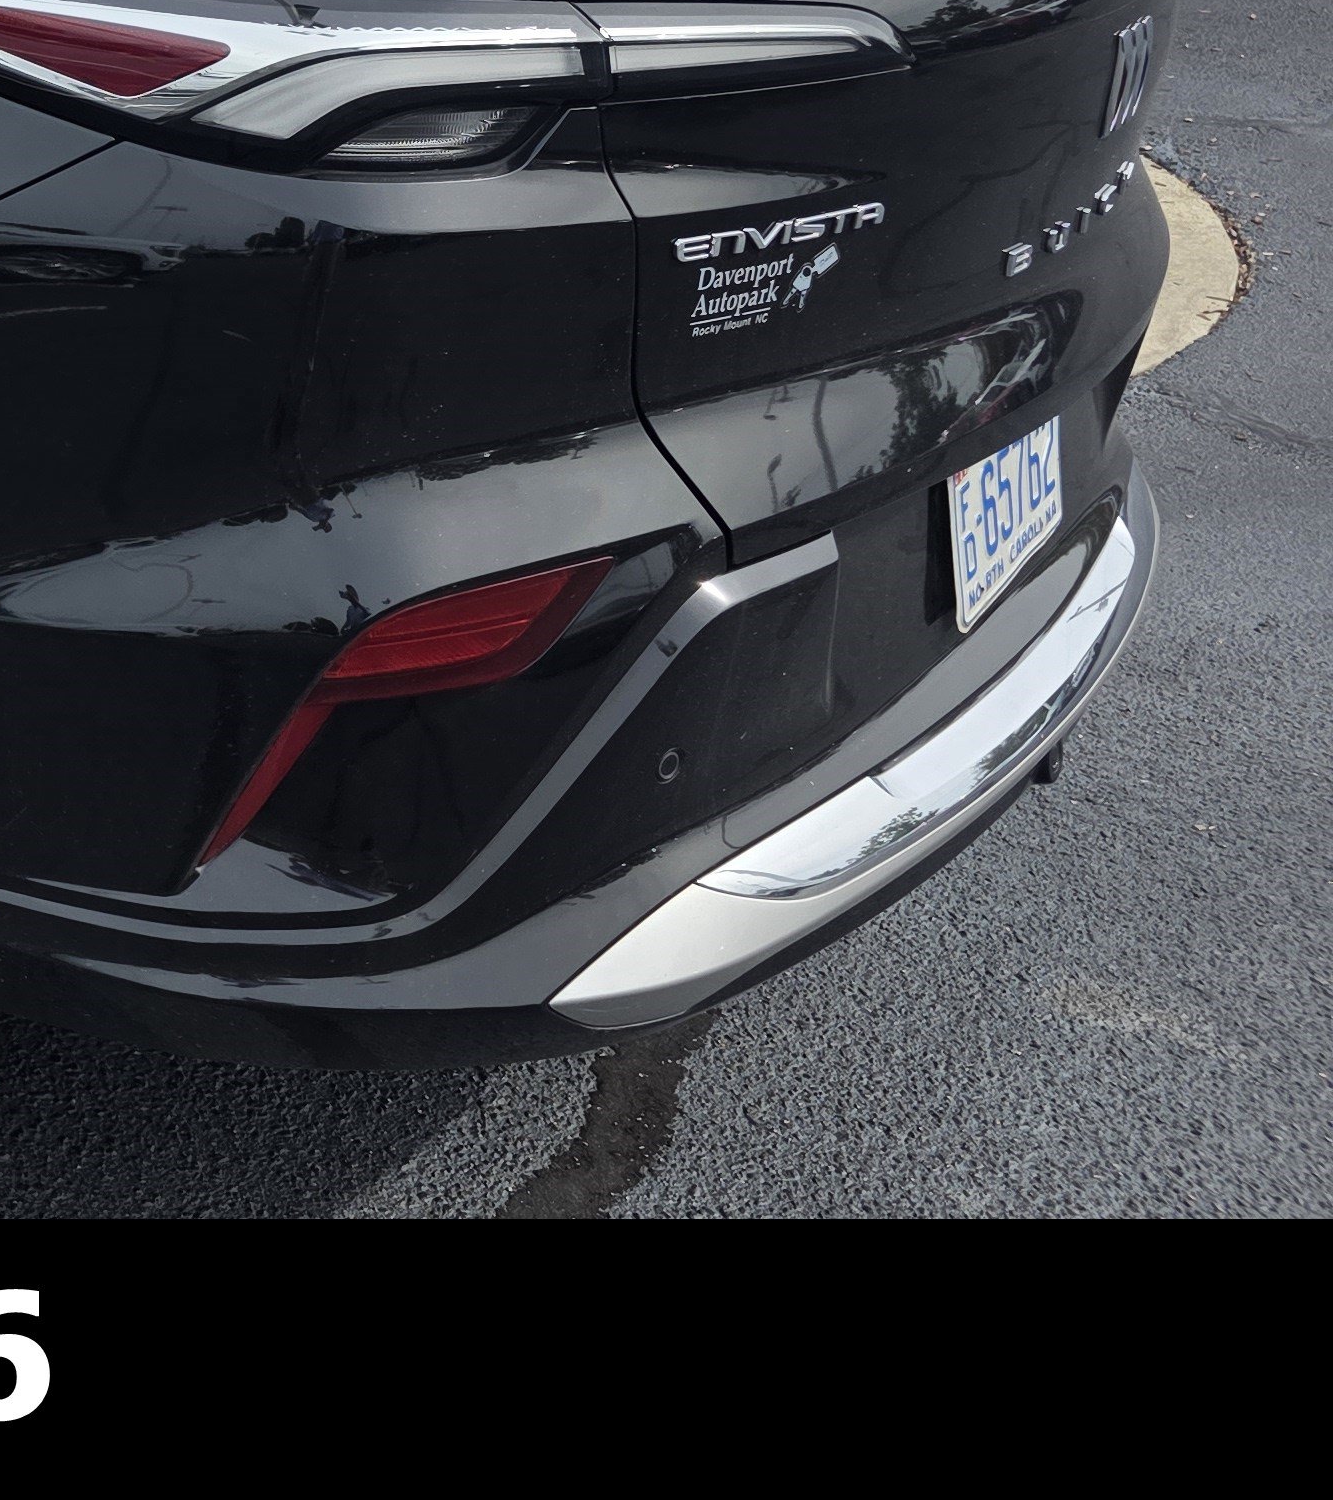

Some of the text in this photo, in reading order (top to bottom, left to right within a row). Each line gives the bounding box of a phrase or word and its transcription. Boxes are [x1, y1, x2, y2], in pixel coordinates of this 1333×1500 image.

[673, 202, 885, 262] ENVISTA
[1002, 161, 1135, 277] BUICK
[697, 253, 794, 291] Davenport
[691, 279, 780, 318] Autopark
[692, 312, 768, 337] Rocky Mount NC
[968, 561, 1005, 608] NORTH
